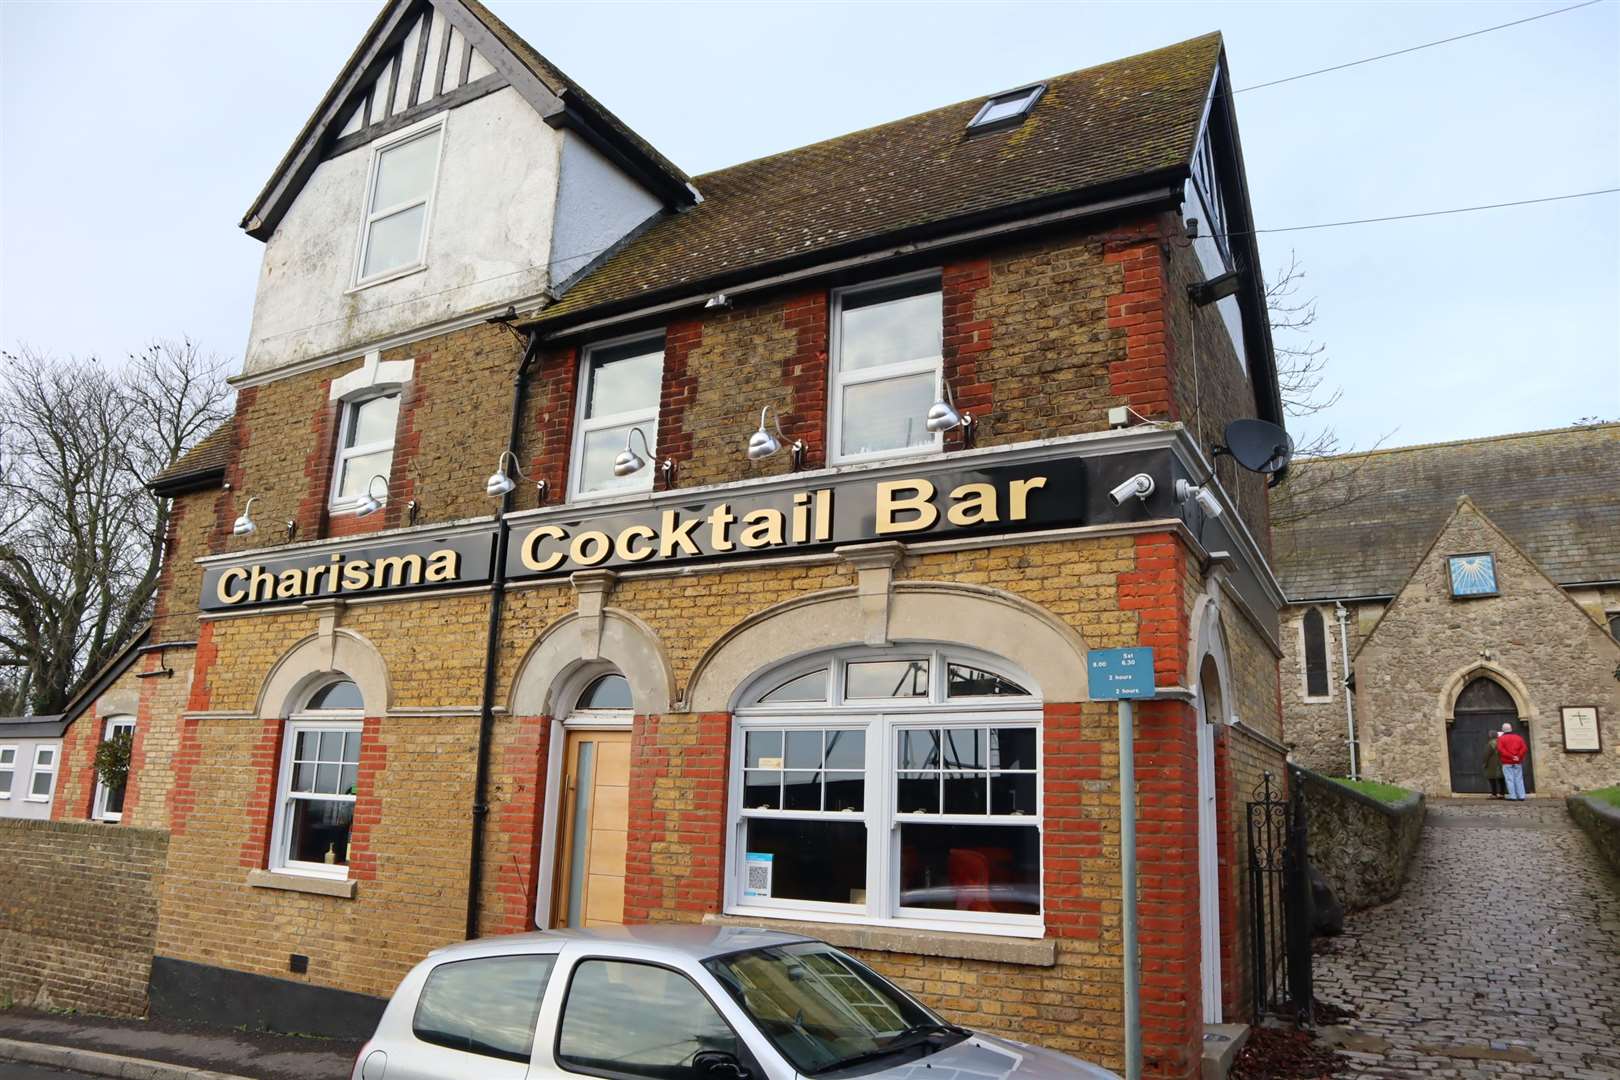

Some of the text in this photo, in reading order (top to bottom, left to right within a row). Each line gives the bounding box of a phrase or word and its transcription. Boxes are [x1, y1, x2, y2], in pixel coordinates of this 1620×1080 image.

[216, 475, 1048, 605] Charisma Cocktail Bar
